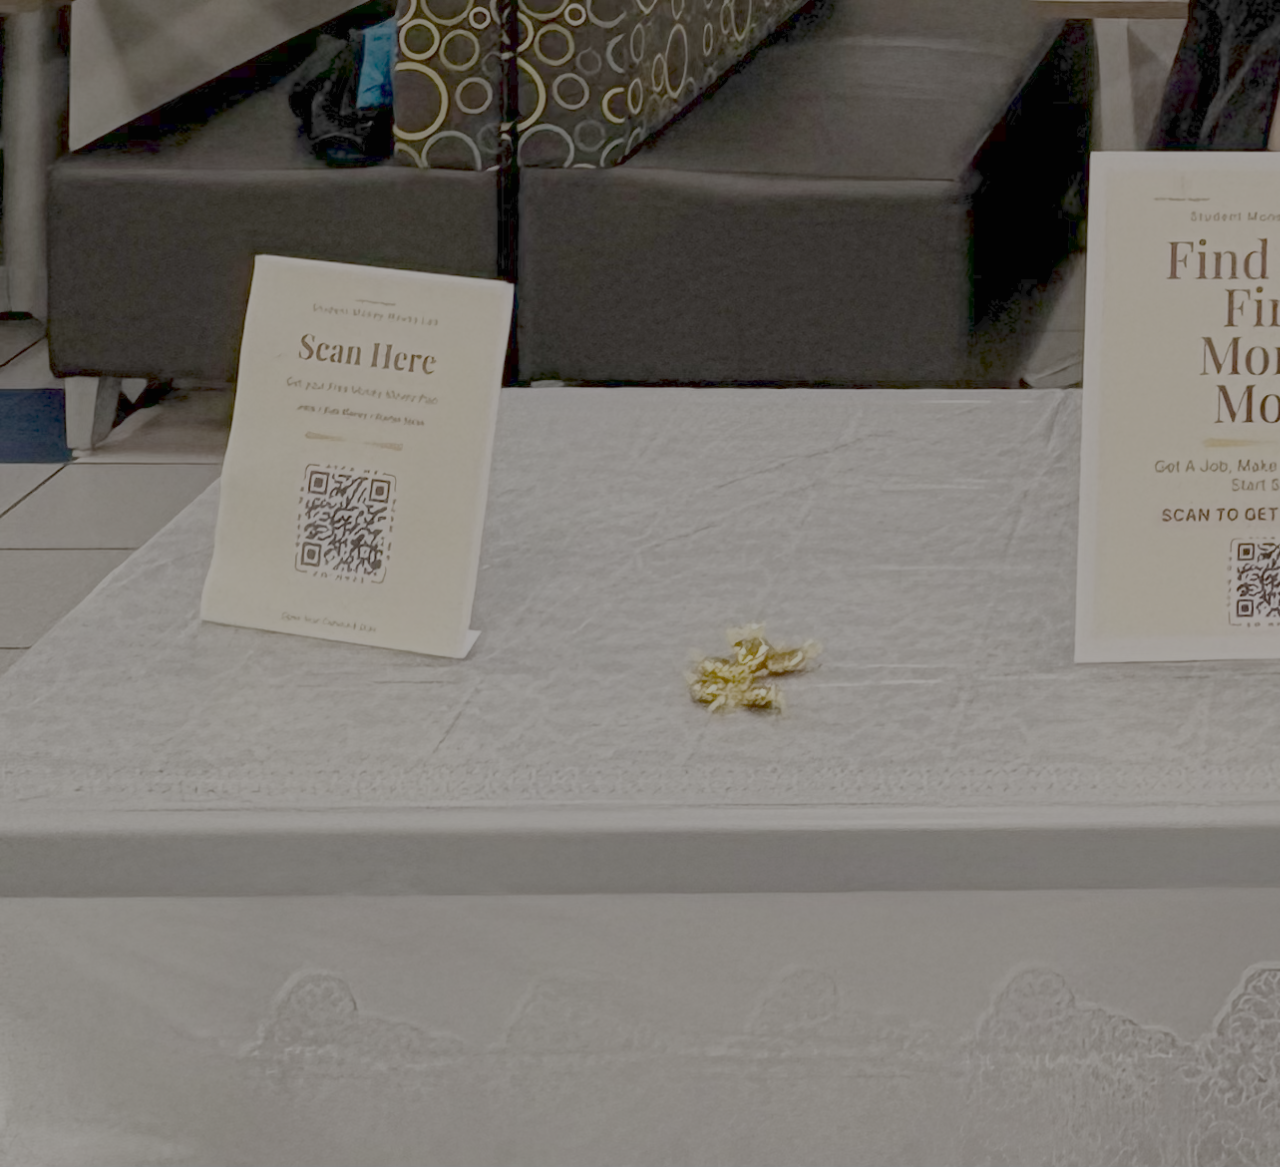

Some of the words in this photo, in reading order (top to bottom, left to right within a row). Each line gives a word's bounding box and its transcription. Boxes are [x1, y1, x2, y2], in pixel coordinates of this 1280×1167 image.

[1167, 237, 1269, 280] Find
[298, 333, 362, 366] Scan
[370, 342, 437, 376] Here
[1185, 460, 1195, 472] A
[1200, 460, 1231, 473] Job,
[1231, 478, 1266, 492] Start
[1162, 508, 1210, 522] SCAN
[1216, 508, 1239, 522] TO
[1244, 507, 1278, 521] GET
